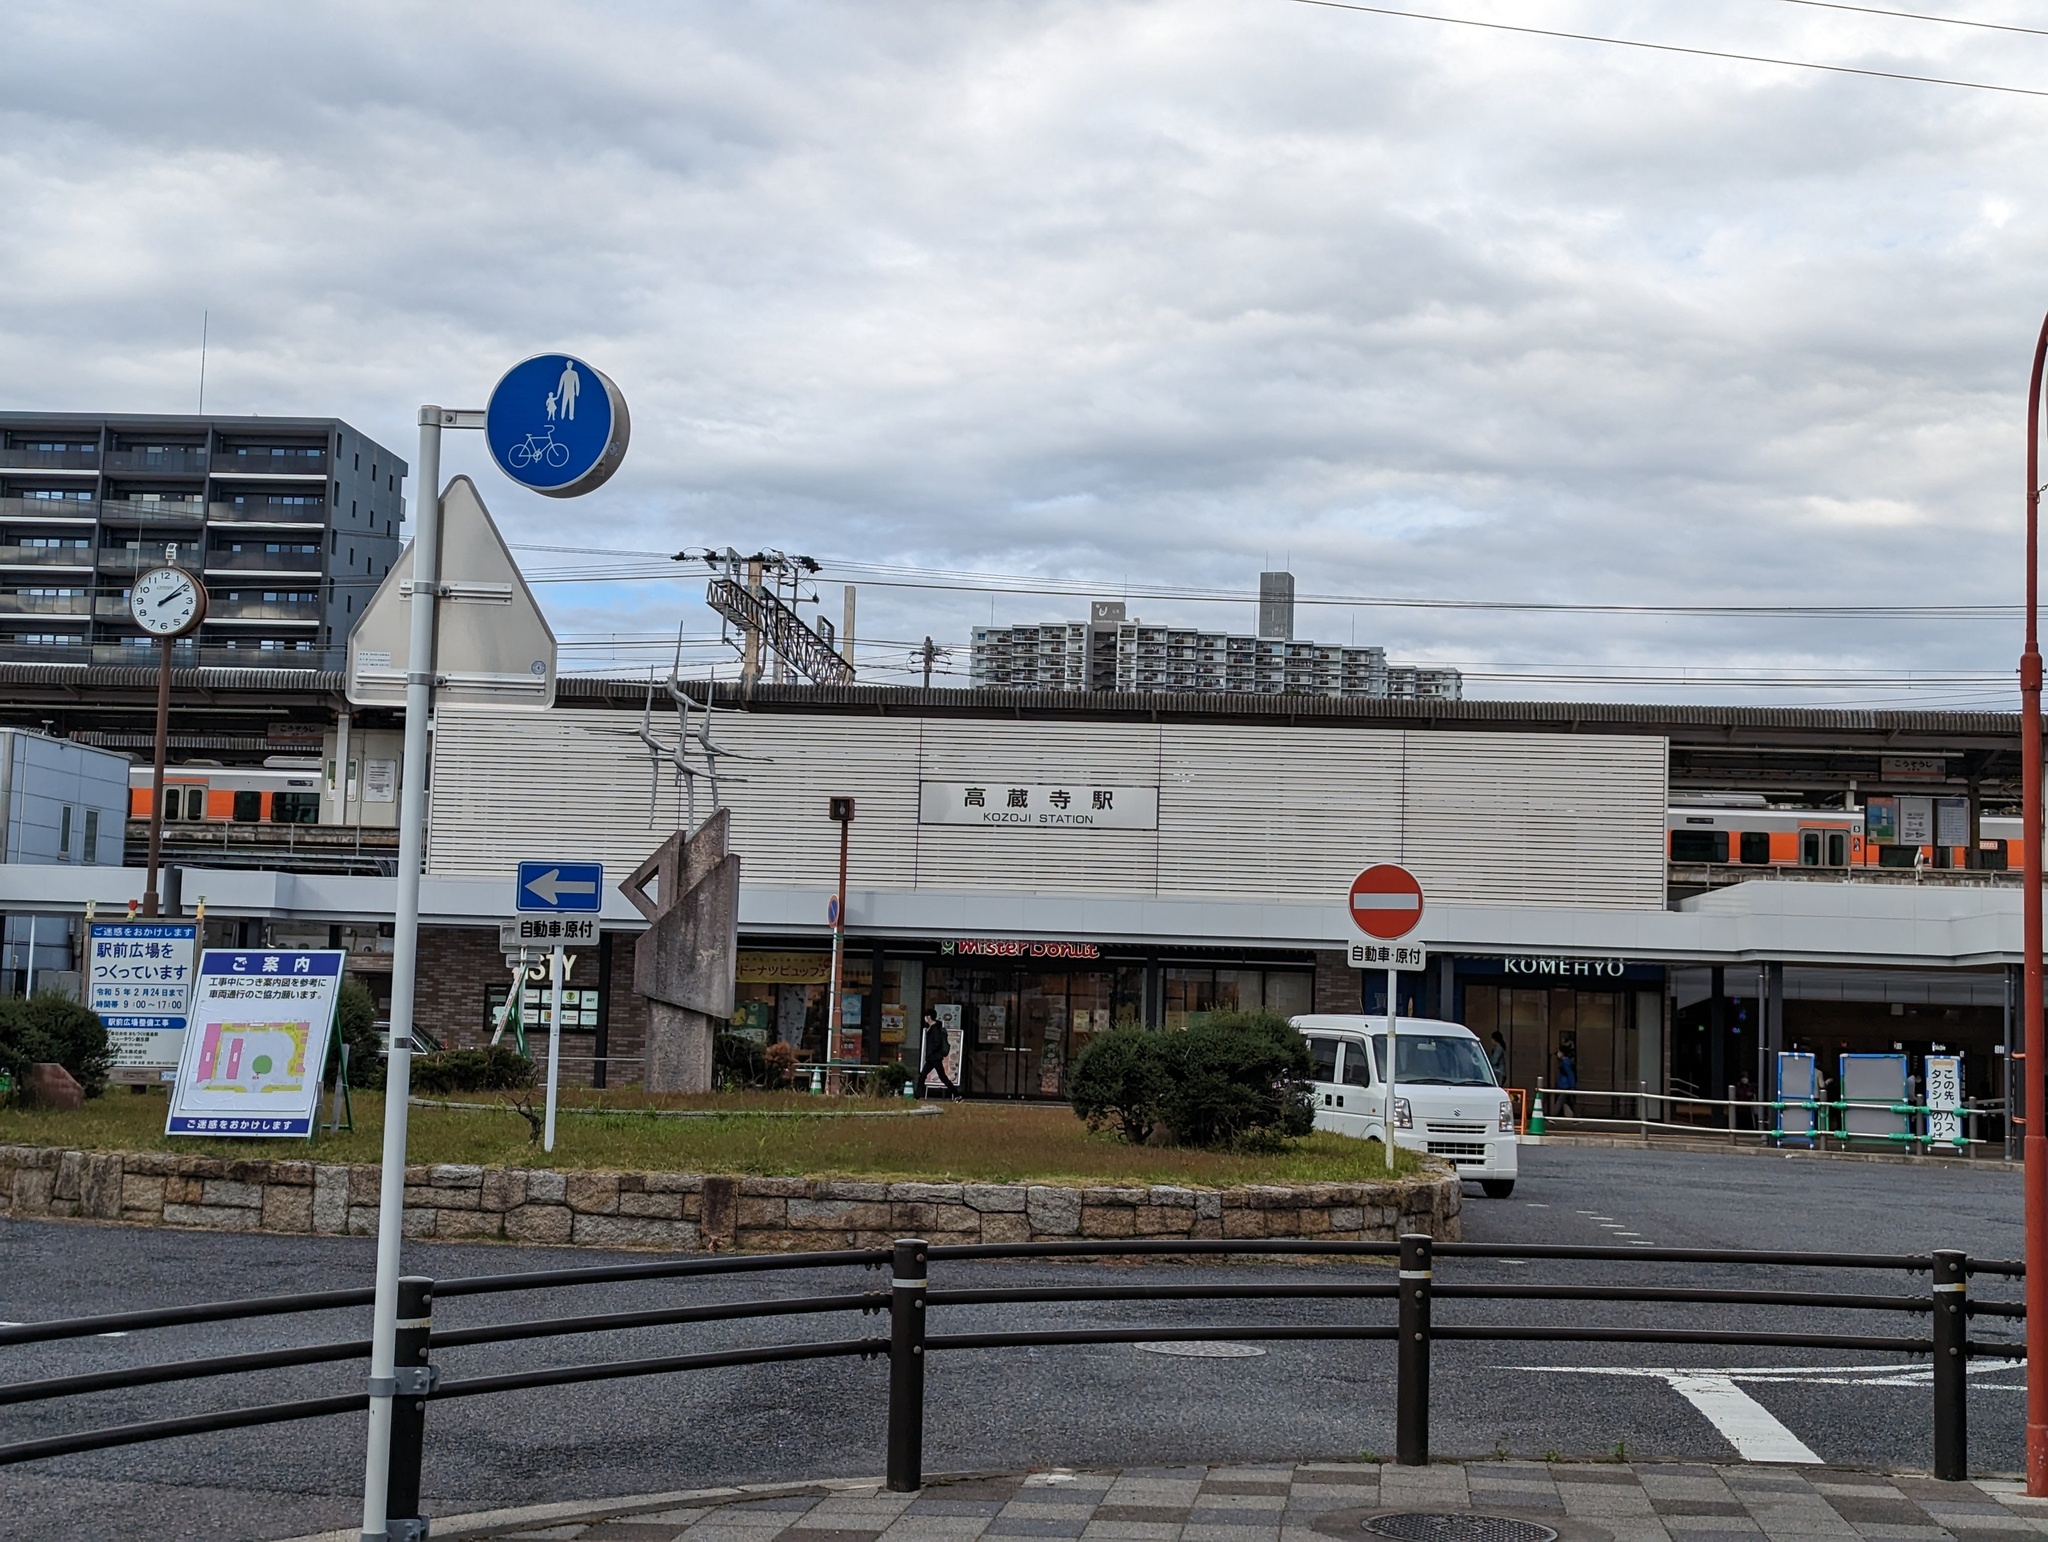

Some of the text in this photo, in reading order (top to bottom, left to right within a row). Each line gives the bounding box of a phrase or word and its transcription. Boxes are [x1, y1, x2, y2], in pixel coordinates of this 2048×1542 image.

[161, 572, 170, 580] 12
[140, 586, 150, 594] 10
[136, 597, 144, 605] 9
[185, 597, 193, 605] 3
[139, 609, 147, 617] 8
[181, 608, 190, 616] 4
[148, 619, 156, 627] 7
[160, 622, 168, 630] 6
[173, 618, 181, 626] 5
[964, 787, 1114, 810] 高蔵寺駅
[983, 812, 1094, 825] KOZOJI STATION
[94, 927, 193, 937] ご迷惑をおかけします
[96, 942, 174, 958] 駅前広場を
[1030, 942, 1100, 959] Donut
[232, 956, 311, 973] ご案内
[512, 954, 577, 981] STY
[1504, 958, 1624, 976] KOMEHYO
[94, 964, 188, 980] つくっています
[739, 965, 827, 977] ドーナツビュッフェ
[208, 977, 327, 988] 工事中につき案内図を参考に
[208, 989, 322, 1000] 車両通行のご協力願います。
[96, 1000, 119, 1009] 時間帯
[108, 1018, 170, 1027] 駅前広場整備工事
[186, 1119, 293, 1130] ご迷惑をおかけします
